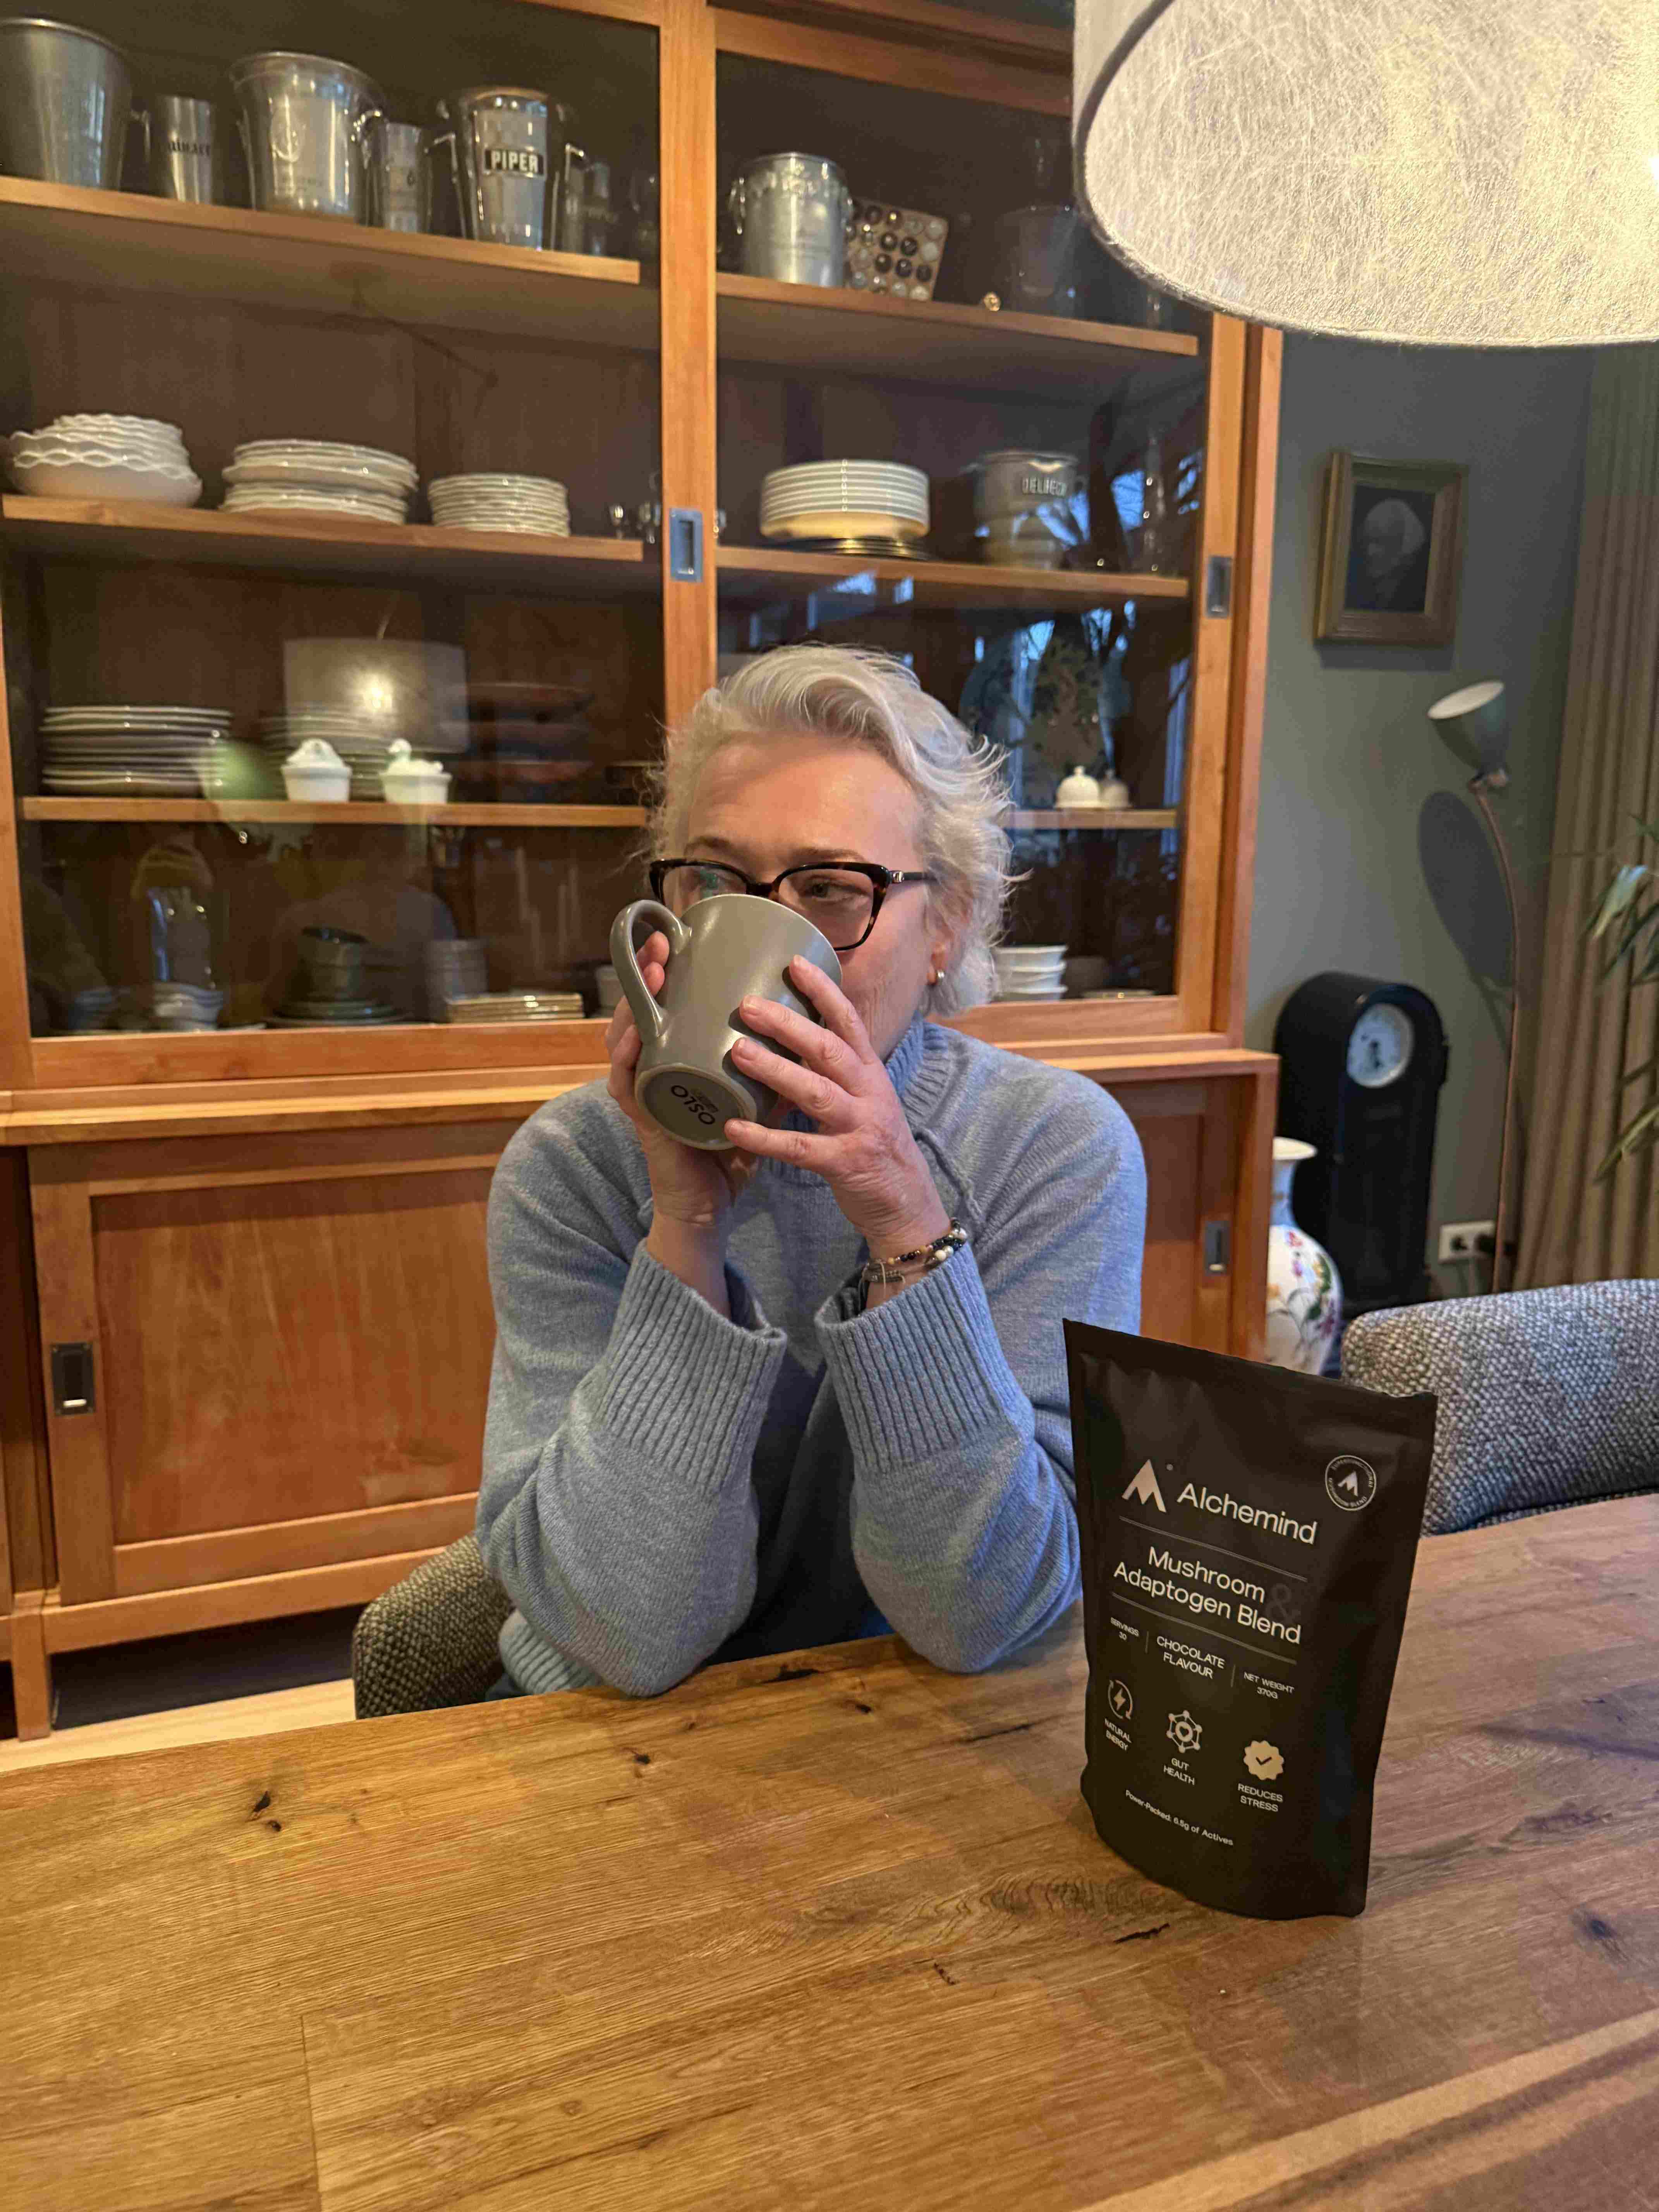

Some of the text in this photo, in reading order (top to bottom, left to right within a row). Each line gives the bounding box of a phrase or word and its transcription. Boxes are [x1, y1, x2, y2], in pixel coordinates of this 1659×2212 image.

[491, 149, 538, 173] PIPER
[671, 1085, 715, 1125] OSLO
[1176, 1483, 1317, 1544] Alchemind
[1148, 1546, 1265, 1603] Mushroom
[1113, 1562, 1302, 1644] Adaptogen Blend
[1111, 1617, 1139, 1637] SERVINGS
[1119, 1631, 1127, 1640] 30
[1156, 1636, 1225, 1669] CHOCOLATE
[1163, 1652, 1213, 1679] FLAVOUR
[1243, 1671, 1295, 1693] NET WEIGHT
[1257, 1686, 1278, 1699] 370G
[1104, 1718, 1132, 1743] NATURAL
[1106, 1729, 1128, 1751] ENERGY
[1163, 1765, 1195, 1785] HEALTH
[1171, 1758, 1189, 1771] GUT
[1238, 1783, 1283, 1803] REDUCES
[1240, 1795, 1278, 1812] STRESS
[1202, 1829, 1233, 1845] Actives
